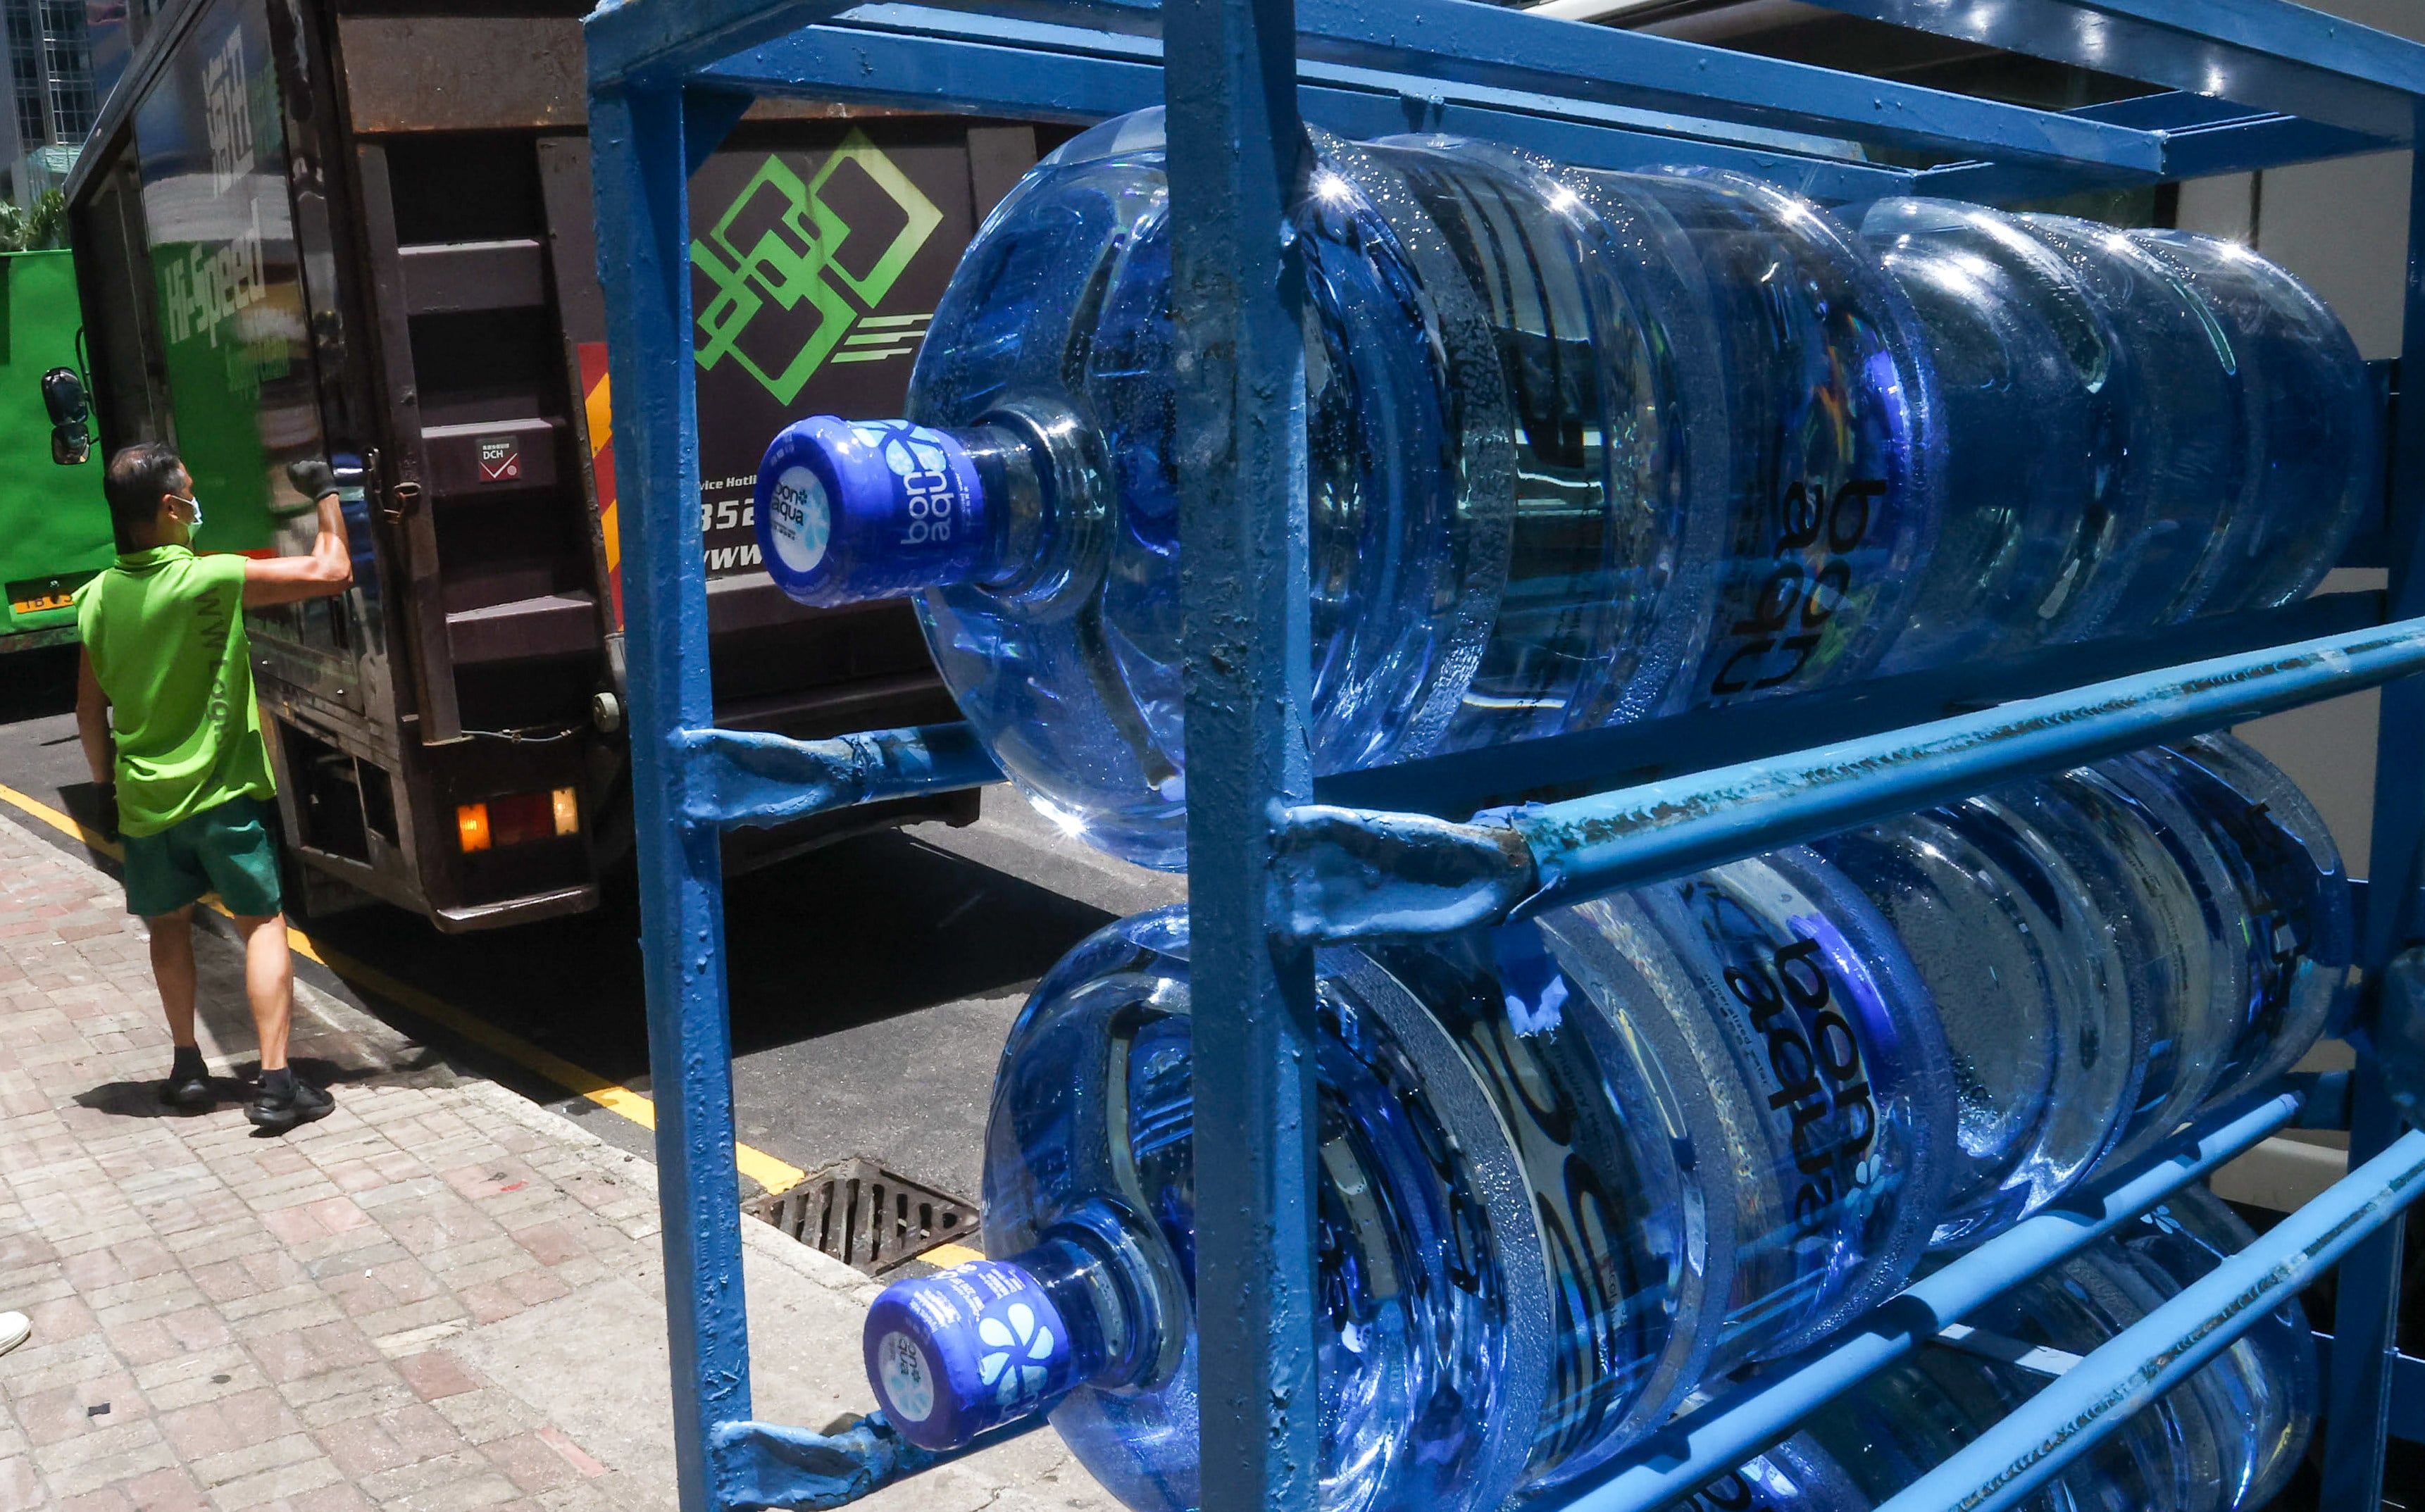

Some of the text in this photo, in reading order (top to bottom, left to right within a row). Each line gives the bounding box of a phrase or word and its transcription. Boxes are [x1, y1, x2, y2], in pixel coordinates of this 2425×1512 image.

[164, 196, 266, 348] Hi-Speed
[482, 449, 504, 460] DCH
[699, 475, 757, 490] vice Hotli
[771, 499, 804, 526] aqua
[901, 471, 928, 545] bon
[925, 470, 954, 542] aqua
[1710, 480, 1825, 695] aqu
[1774, 938, 1875, 1162] bon
[1723, 965, 1829, 1241] aqua
